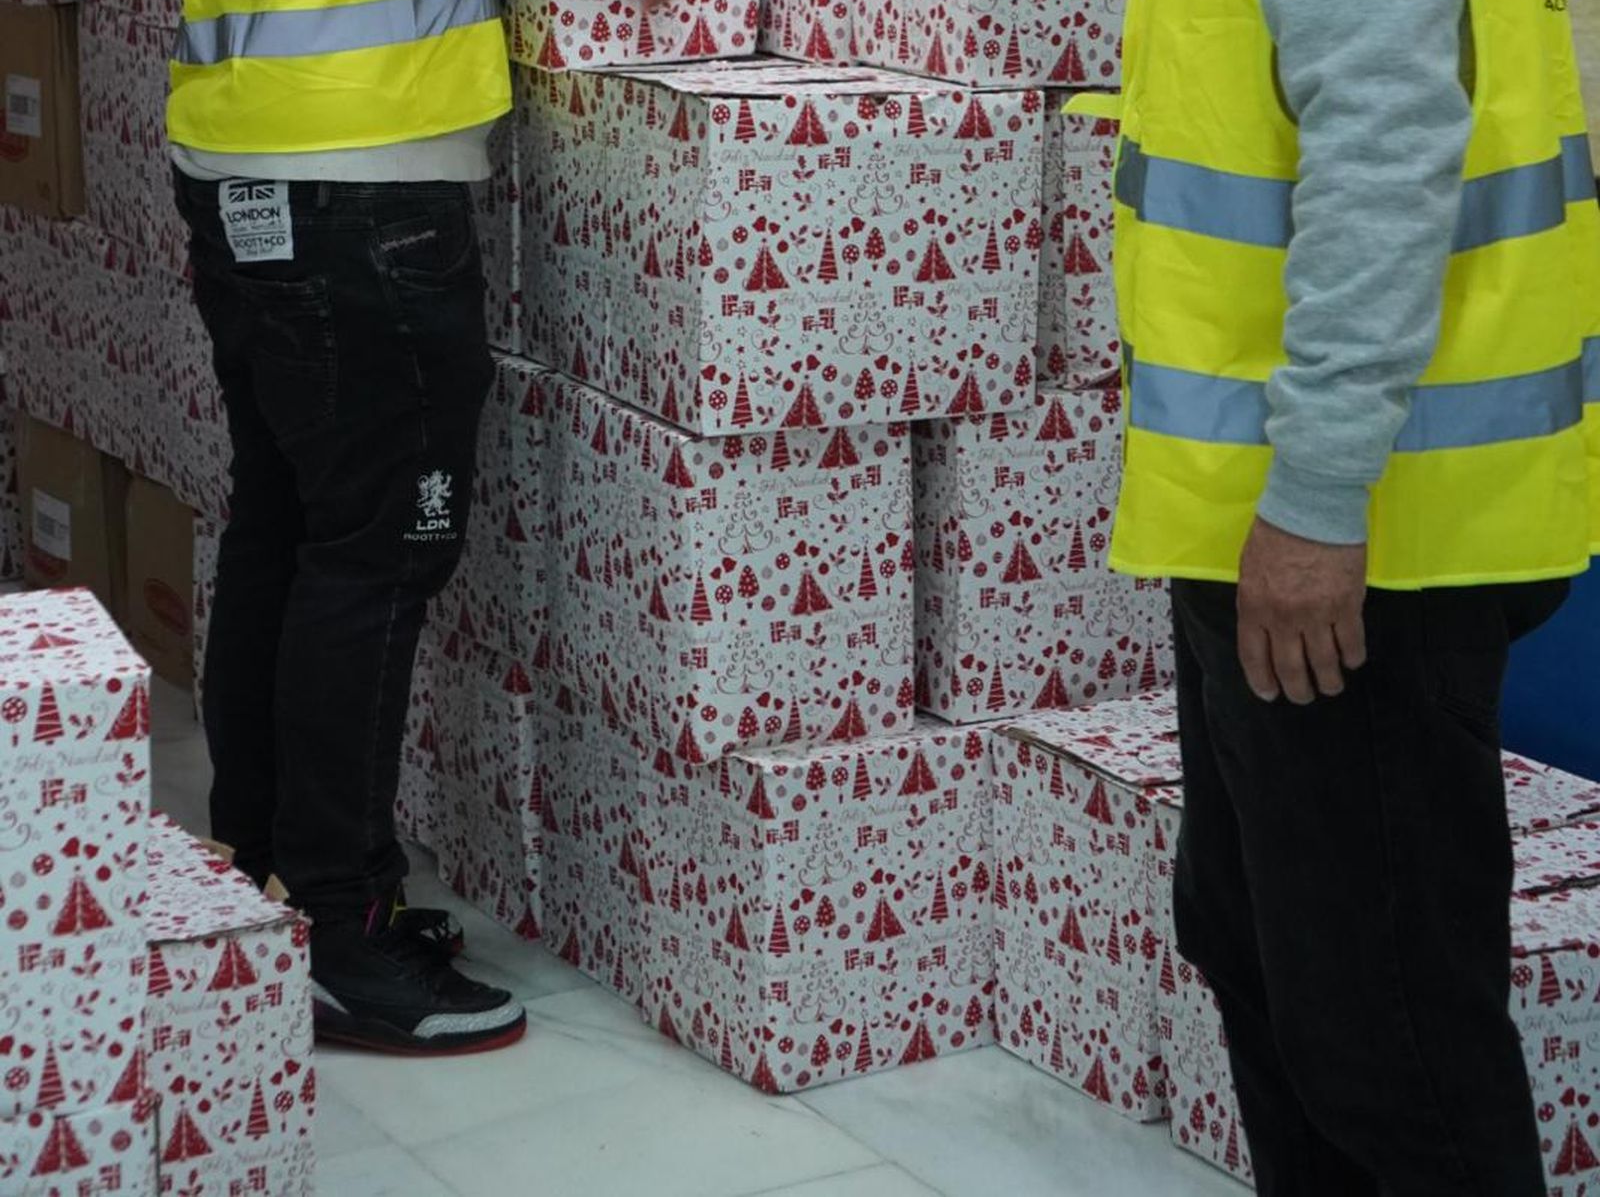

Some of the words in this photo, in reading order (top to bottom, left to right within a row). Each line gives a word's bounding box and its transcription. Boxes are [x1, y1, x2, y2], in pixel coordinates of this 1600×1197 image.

[225, 206, 281, 224] LONDON
[416, 518, 450, 531] LDN
[56, 743, 124, 767] Navidad
